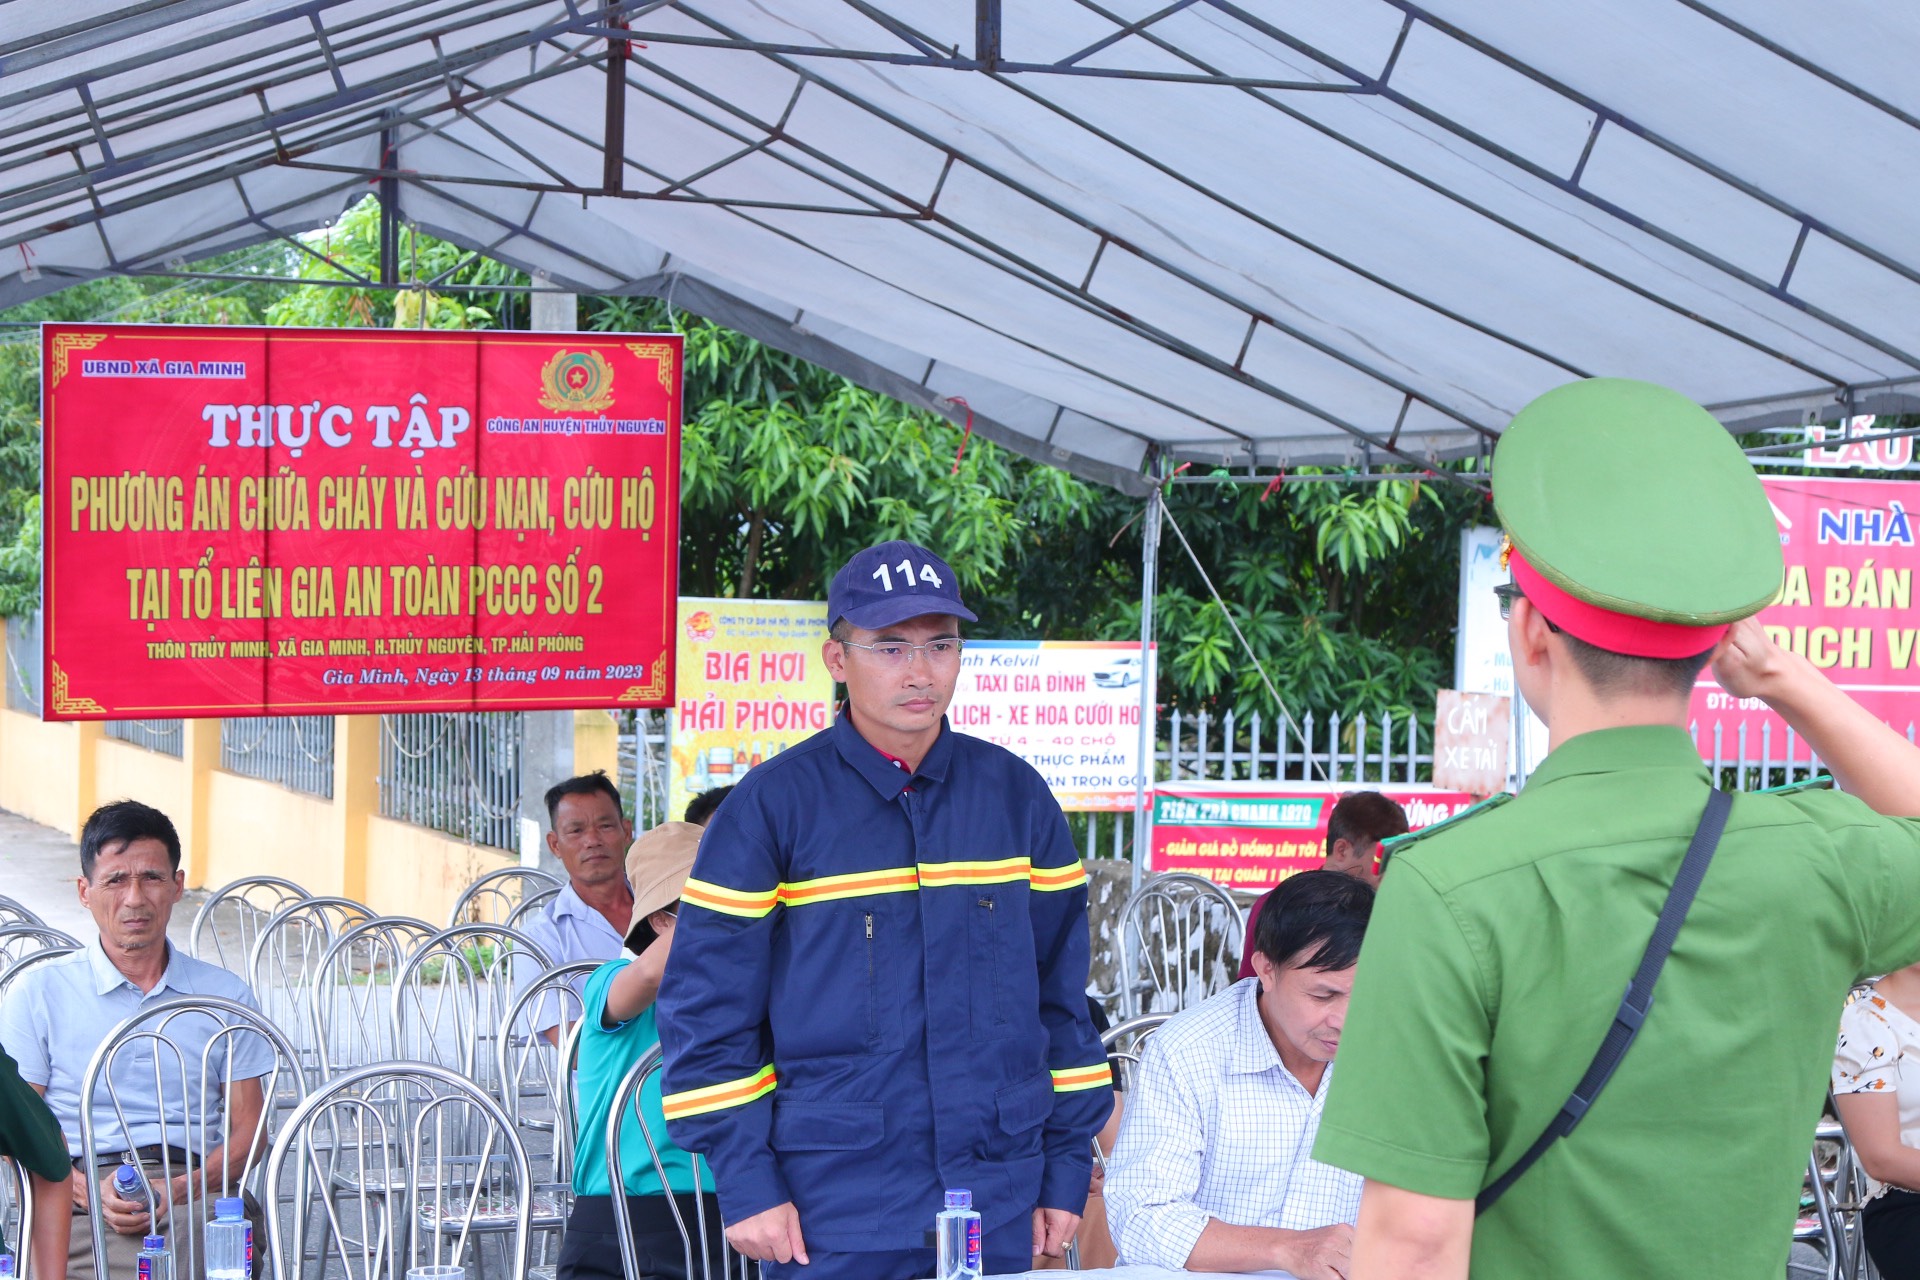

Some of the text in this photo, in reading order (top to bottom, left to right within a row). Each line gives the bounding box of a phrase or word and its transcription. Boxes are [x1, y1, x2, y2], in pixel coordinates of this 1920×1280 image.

[83, 358, 245, 376] UBND XÃ GIA MINH
[202, 392, 470, 458] THỰC TẬP
[488, 415, 665, 436] CÔNG AN HUYỆN THỦY NGUYÊN
[70, 465, 655, 542] PHƯƠNG ÁN CHỮA CHÁY VÀ CỨU NẠN, CỨU HỘ
[1818, 500, 1914, 546] NHÀ
[126, 546, 603, 632] TẠI TỔ LIÊN GIA AN TOÀN PCCC SỐ 2
[872, 559, 942, 592] 114
[1824, 559, 1912, 609] BÁN
[147, 630, 584, 659] THÔN THỦY MINH, XÃ GIA MINH, H.THỦY NGUYÊN, TP.HẢI PHÒNG
[960, 654, 983, 667] nh
[1886, 629, 1920, 669] V
[322, 664, 644, 687] Gia Minh, Ngày 13 tháng 09 năm 2023
[706, 652, 805, 684] BIA HƠI
[975, 674, 1007, 692] TAXI
[1014, 674, 1041, 692] GIA
[1047, 671, 1086, 692] ĐÌNH
[680, 692, 826, 732] HẢI PHÒNG
[953, 705, 990, 729] LỊCH
[1009, 705, 1029, 725] XE
[1035, 705, 1068, 725] HOA
[1075, 700, 1113, 725] CƯỚI
[1120, 697, 1142, 725] HỎ
[1448, 694, 1487, 735] CẤM
[1052, 736, 1074, 745] 40
[1444, 746, 1470, 769] XE
[1166, 838, 1197, 857] GIẢM
[1198, 839, 1219, 857] GIÁ
[1240, 837, 1274, 857] UỐNG
[1275, 840, 1297, 858] LÊN
